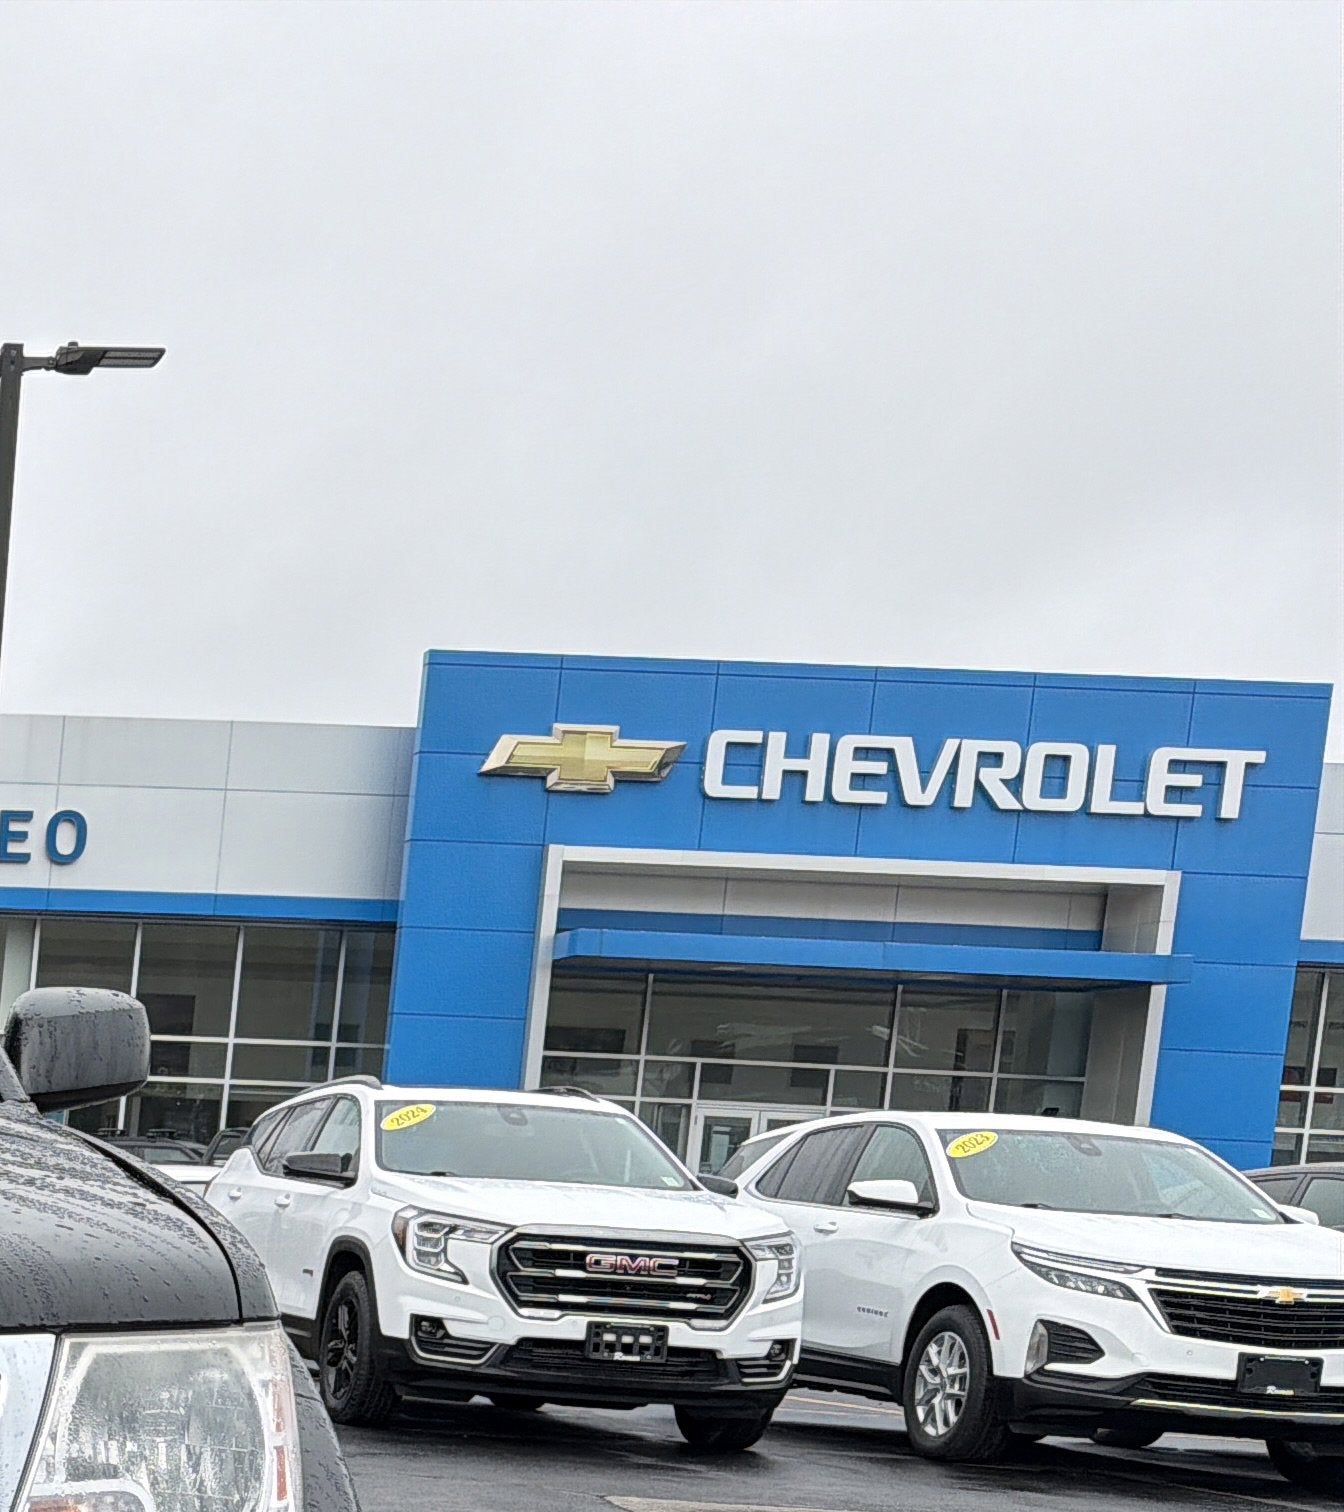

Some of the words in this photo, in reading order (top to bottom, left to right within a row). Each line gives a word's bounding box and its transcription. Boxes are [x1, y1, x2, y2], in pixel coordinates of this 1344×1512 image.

[703, 729, 1267, 820] CHEVROLET
[390, 1106, 428, 1127] 2024
[955, 1133, 990, 1154] 2023
[585, 1253, 679, 1277] GMC
